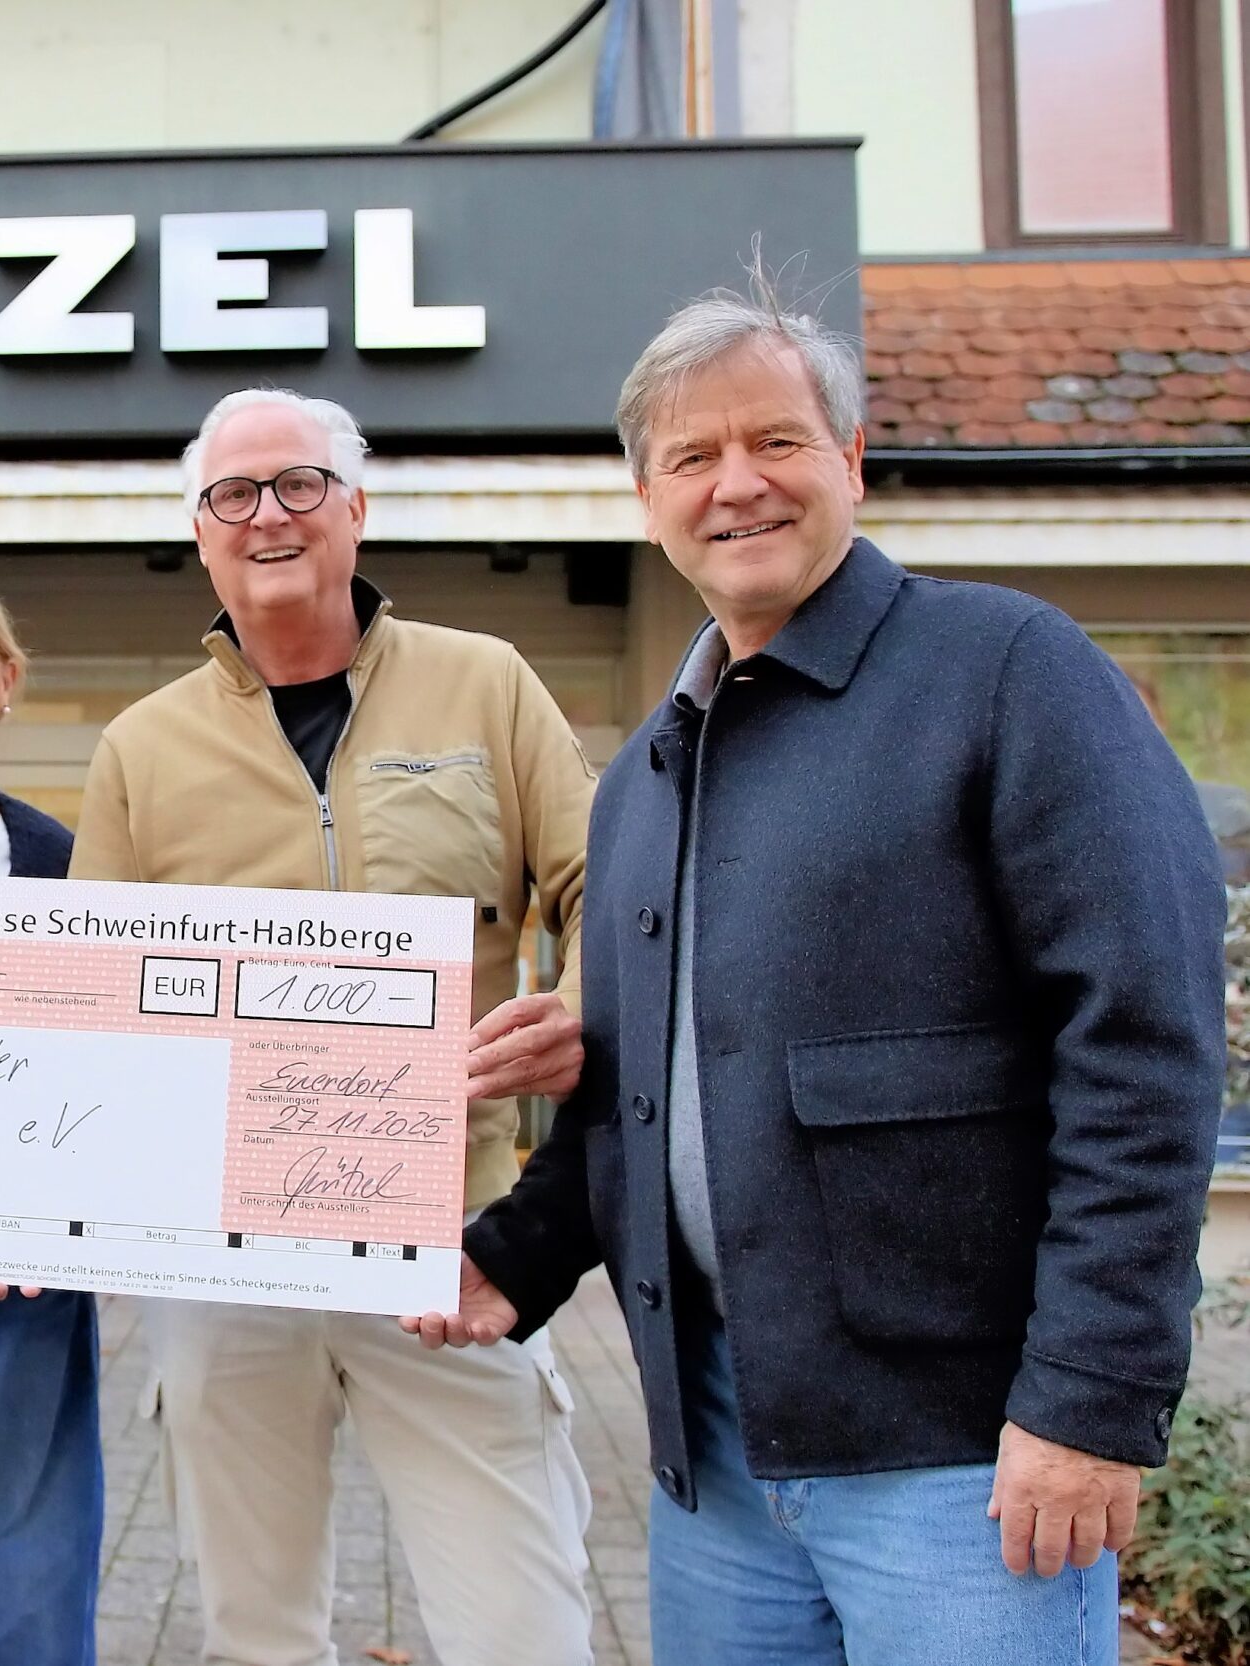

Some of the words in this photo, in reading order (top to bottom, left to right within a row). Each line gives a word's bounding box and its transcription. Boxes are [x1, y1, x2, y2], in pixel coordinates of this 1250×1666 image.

[47, 908, 413, 957] Schweinfurt-Haßberge
[310, 959, 331, 969] Cent
[155, 976, 205, 997] EUR
[14, 994, 30, 1003] wie
[32, 995, 97, 1006] nebenstehend
[249, 1040, 269, 1050] oder
[273, 1040, 330, 1053] Überbringer
[259, 1062, 412, 1102] Euerdorf
[246, 1093, 320, 1106] Ausstellungsort
[243, 1134, 275, 1145] Datum
[240, 1197, 296, 1209] Unterschrift
[299, 1200, 315, 1210] des
[318, 1202, 370, 1213] Ausstellers
[146, 1230, 177, 1242] Betrag
[295, 1241, 311, 1250] BIC
[382, 1246, 401, 1257] Text
[41, 1264, 60, 1273] und
[63, 1265, 87, 1275] stellt
[90, 1267, 123, 1278] keinen
[126, 1269, 160, 1281] Scheck
[163, 1272, 175, 1281] im
[178, 1273, 206, 1284] Sinne
[209, 1275, 227, 1286] des
[230, 1277, 310, 1292] Scheckgesetzes
[313, 1283, 332, 1294] dar.
